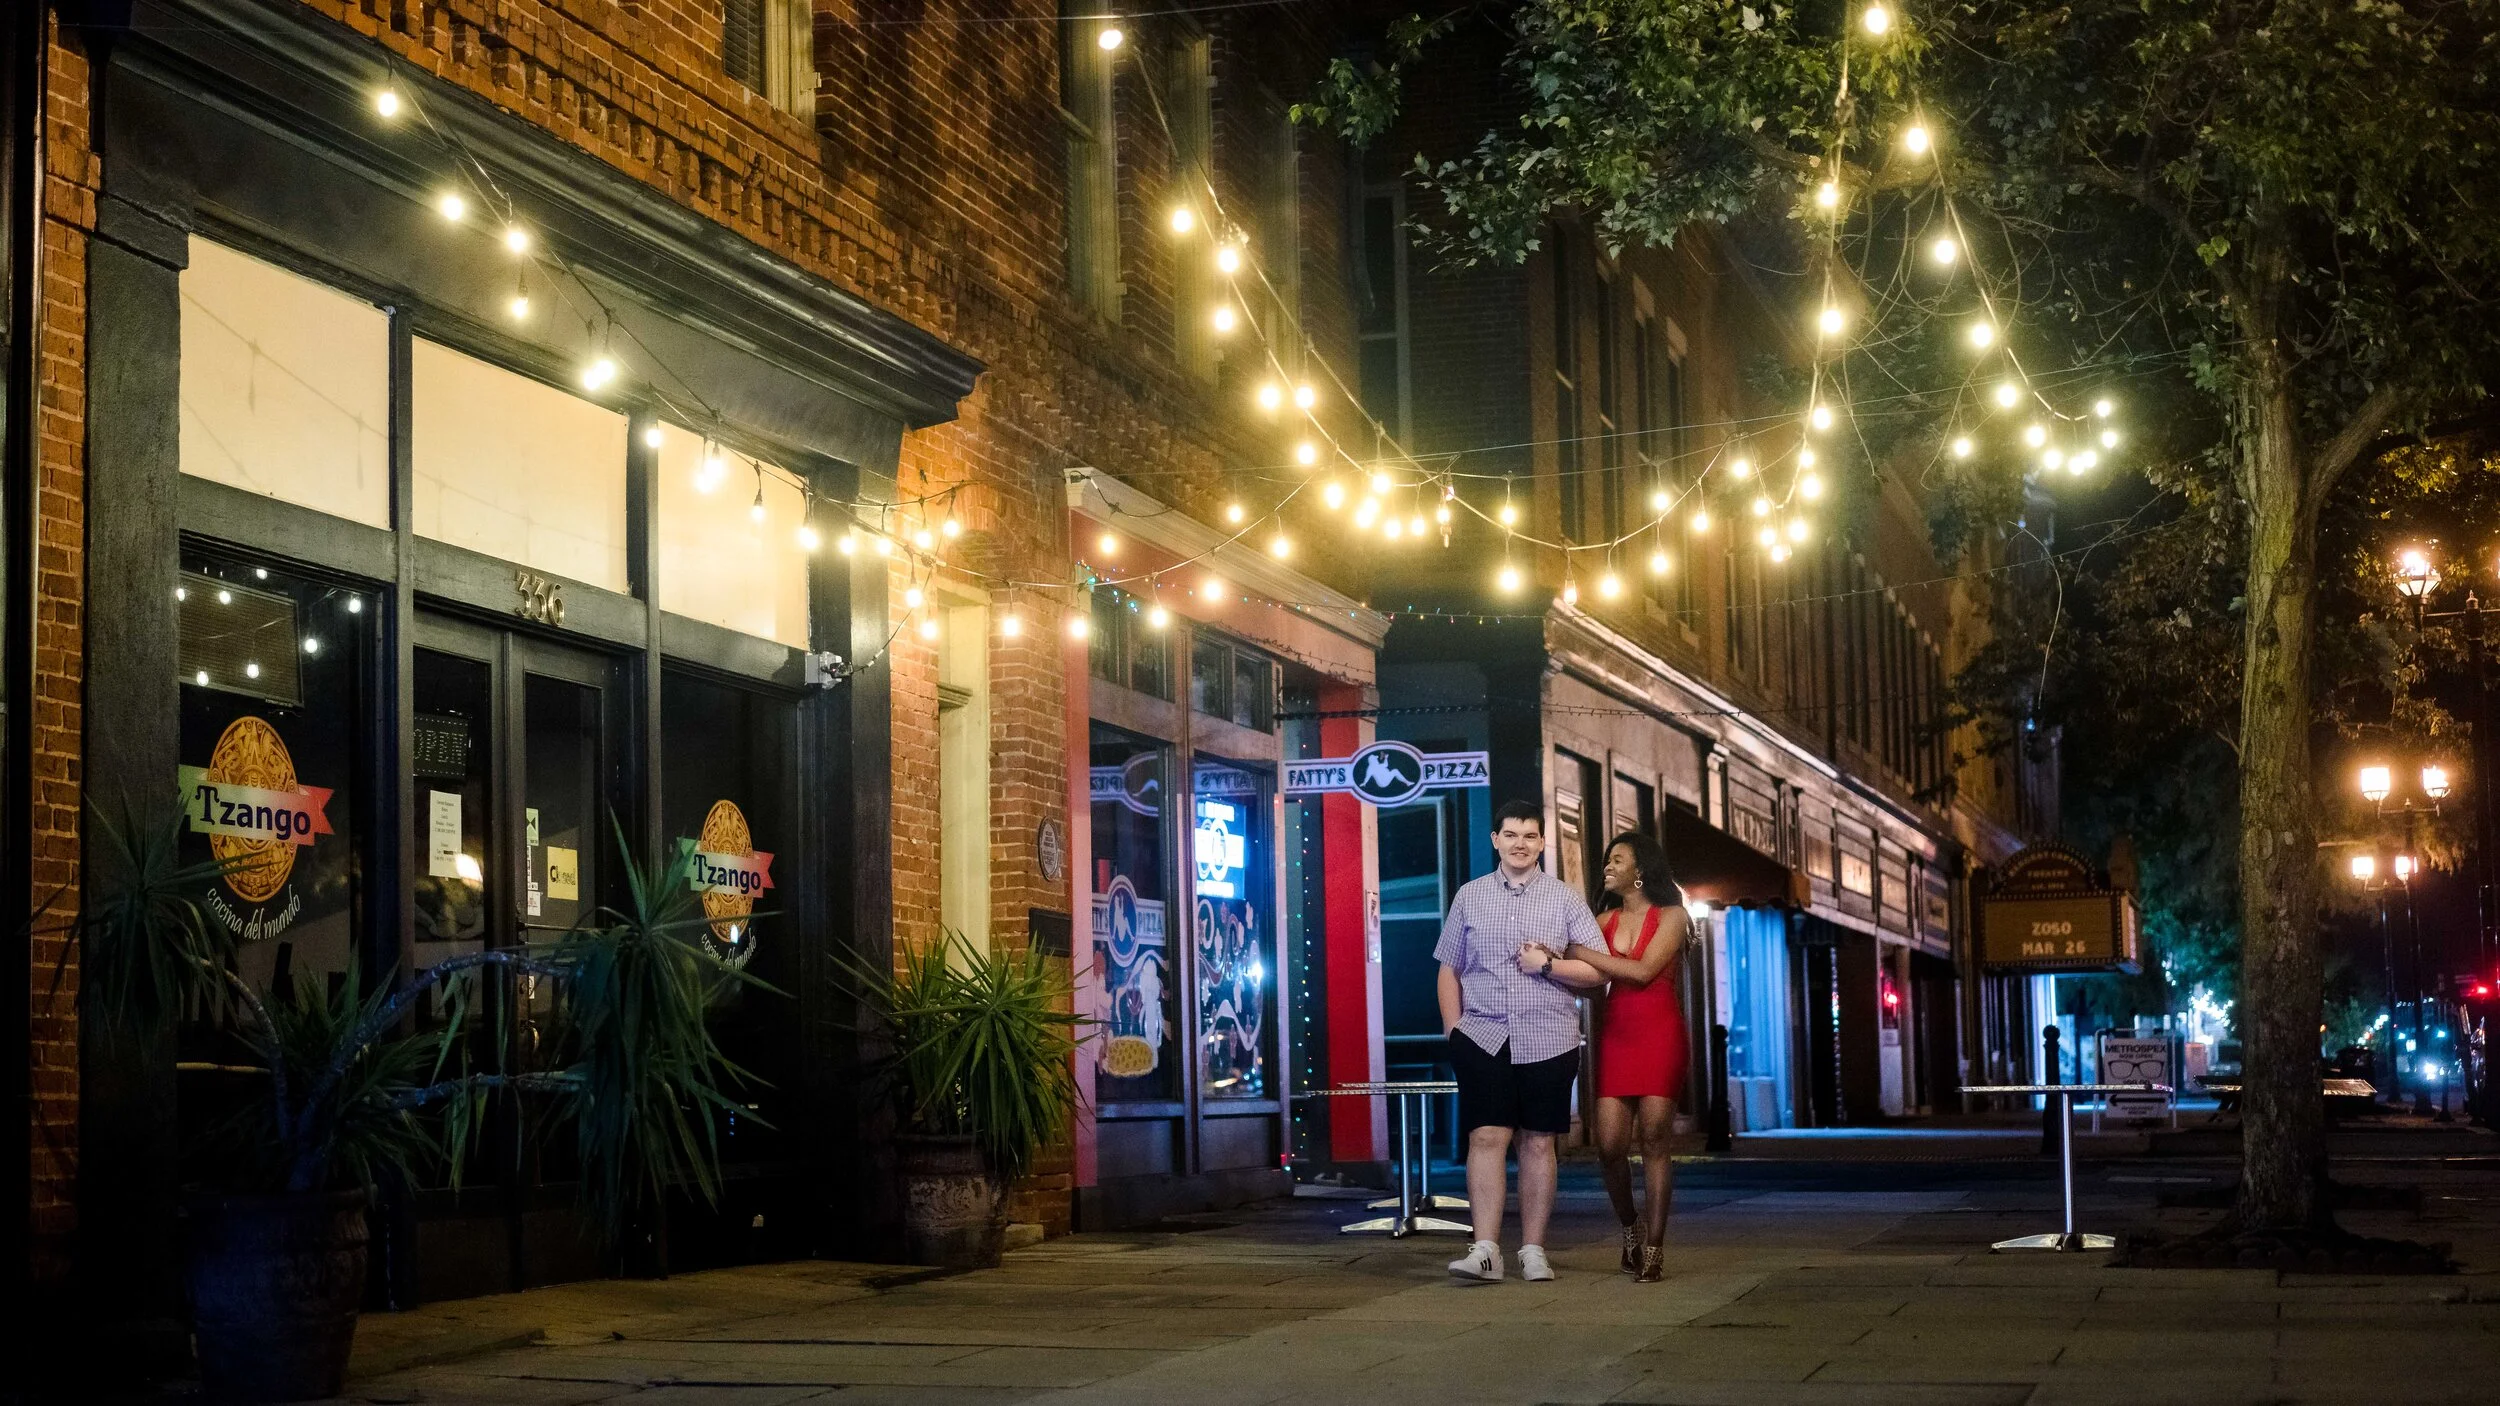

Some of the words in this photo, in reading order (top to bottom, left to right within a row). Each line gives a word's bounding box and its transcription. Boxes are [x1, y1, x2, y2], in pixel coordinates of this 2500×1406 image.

[515, 570, 565, 626] 336
[1287, 767, 1346, 787] FATTY'S
[1423, 761, 1488, 780] PIZZA
[194, 784, 311, 840] Tzango
[693, 854, 761, 894] Tzango
[207, 887, 244, 935] cocina
[244, 907, 265, 940] del
[263, 884, 301, 940] mundo
[1137, 911, 1163, 935] PIZZA
[2031, 921, 2072, 936] ZOSO
[2021, 941, 2055, 956] MAR
[2064, 940, 2086, 955] 26
[2105, 1044, 2167, 1053] METROSPEX
